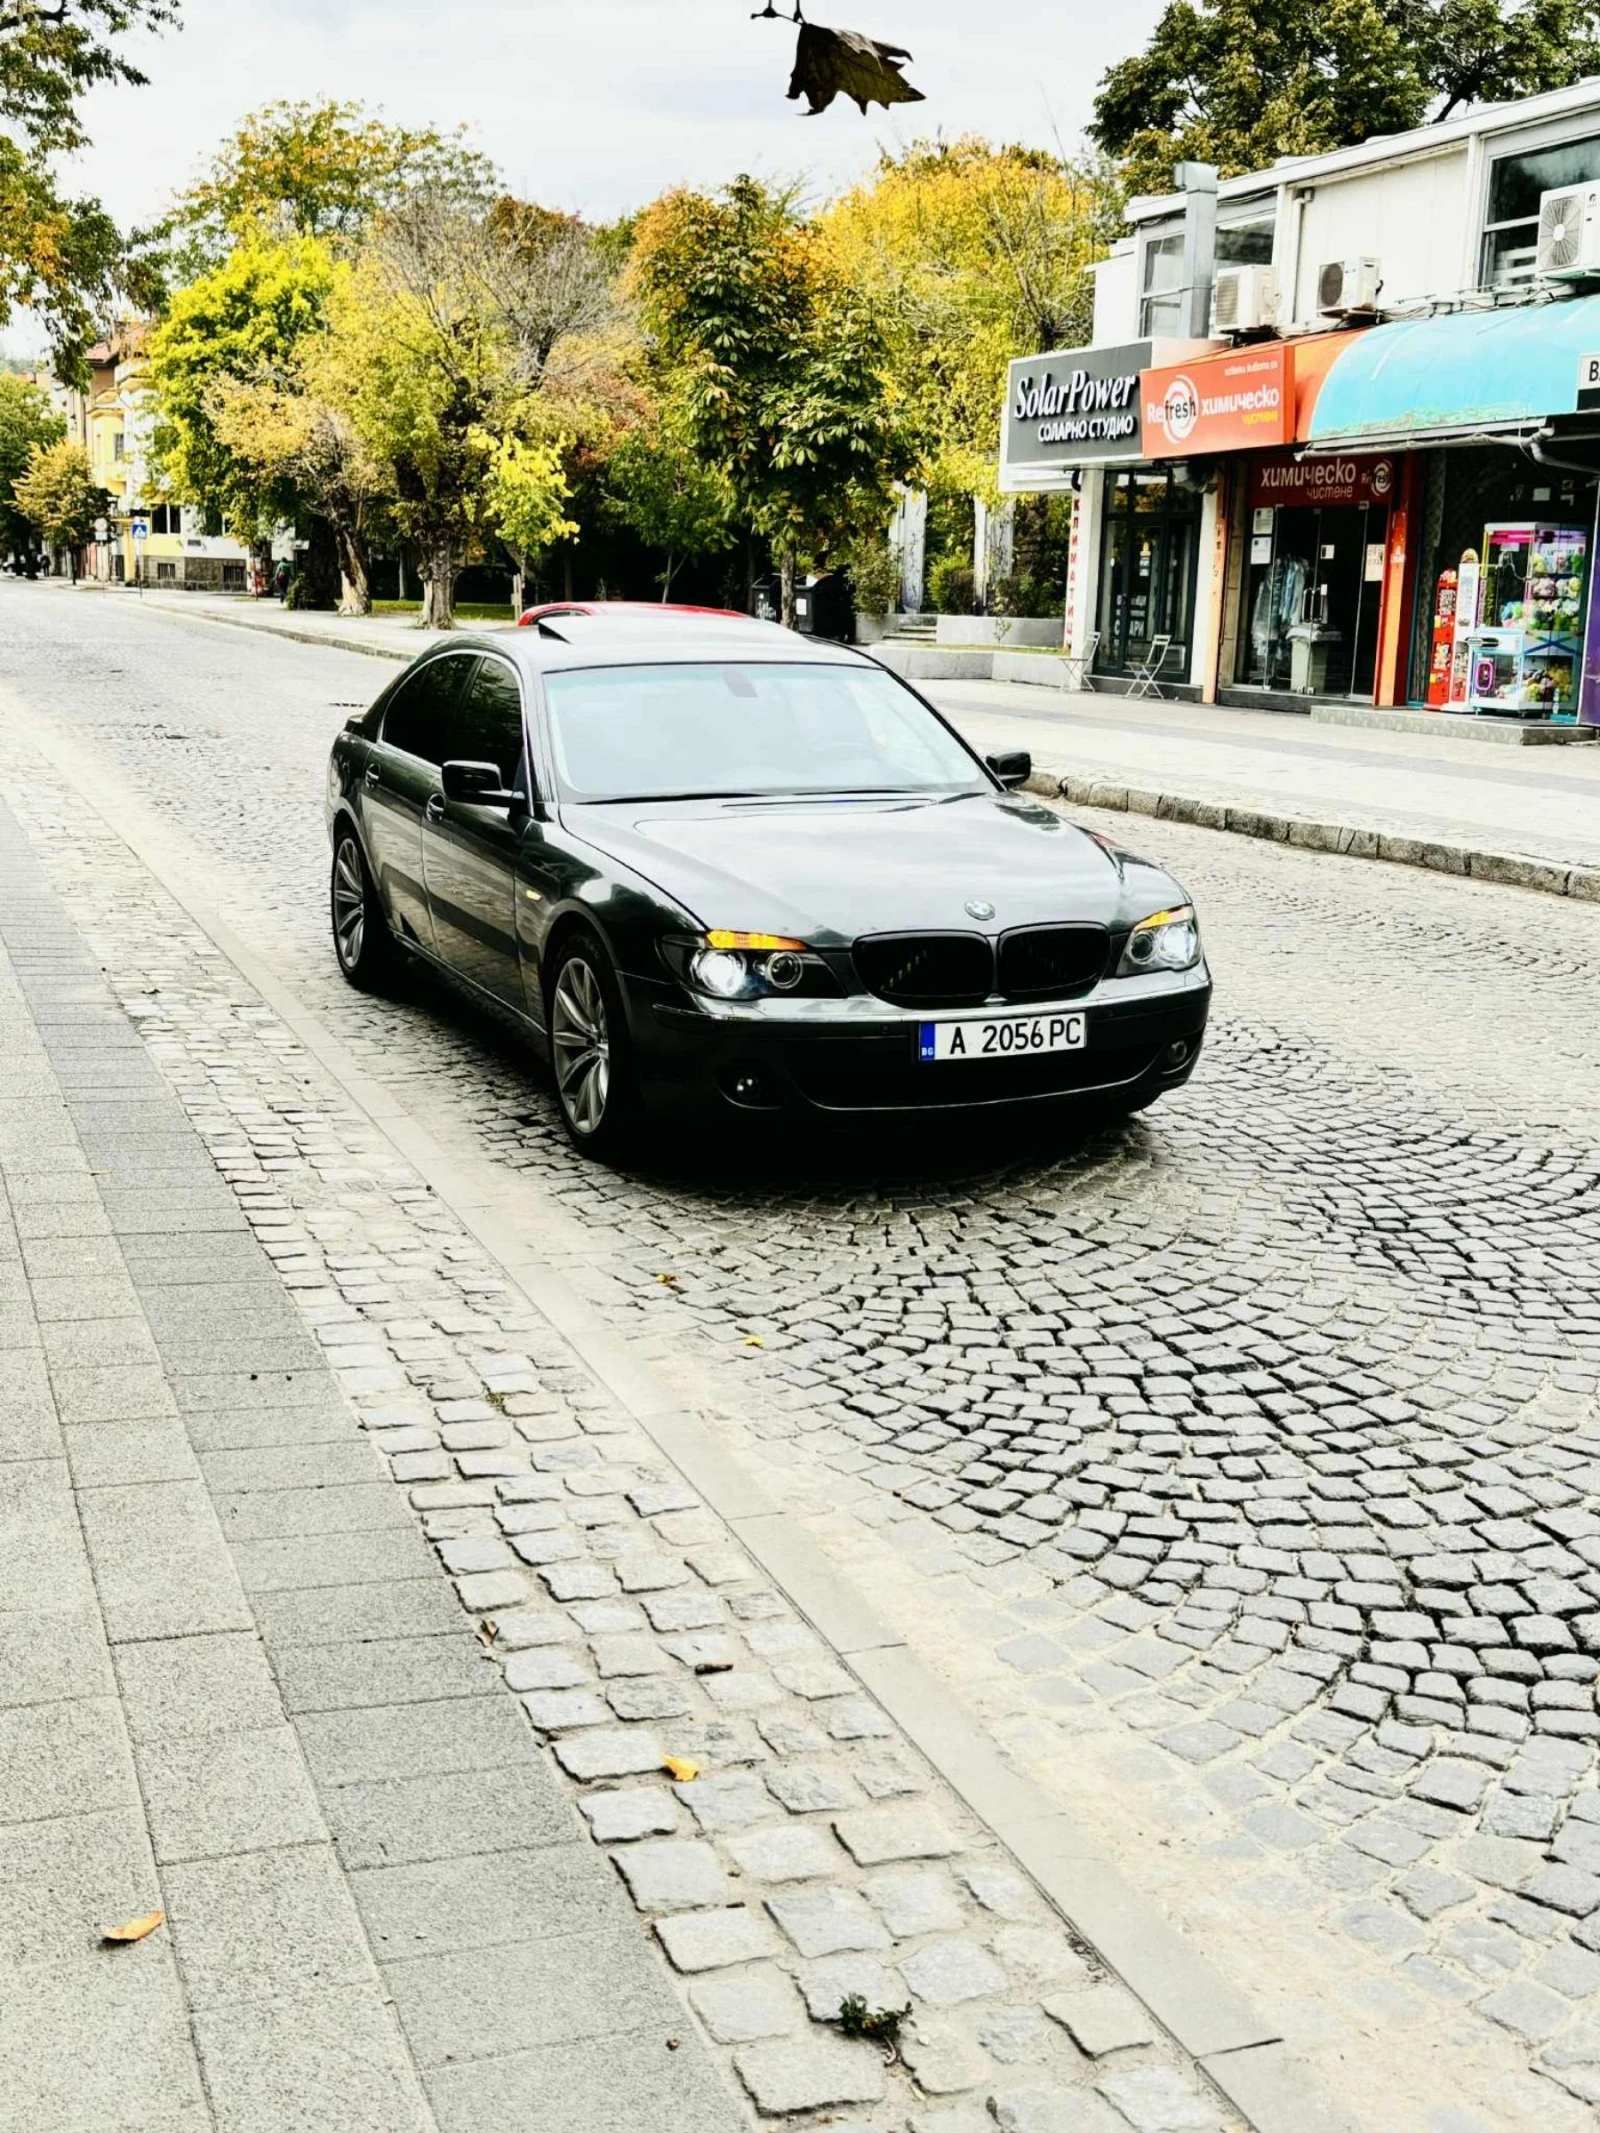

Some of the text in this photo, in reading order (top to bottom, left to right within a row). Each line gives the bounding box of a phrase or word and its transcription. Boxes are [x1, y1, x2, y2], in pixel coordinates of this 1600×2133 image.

[1014, 370, 1136, 419] SolarPower
[1201, 384, 1279, 416] химическо
[1147, 396, 1196, 424] Refresh
[1038, 415, 1134, 442] СОЛАРНО СТУДИО
[1261, 458, 1356, 487] химическо
[1307, 485, 1353, 499] чистене
[950, 1017, 1081, 1055] A 2056 PC
[921, 1047, 934, 1056] BG
